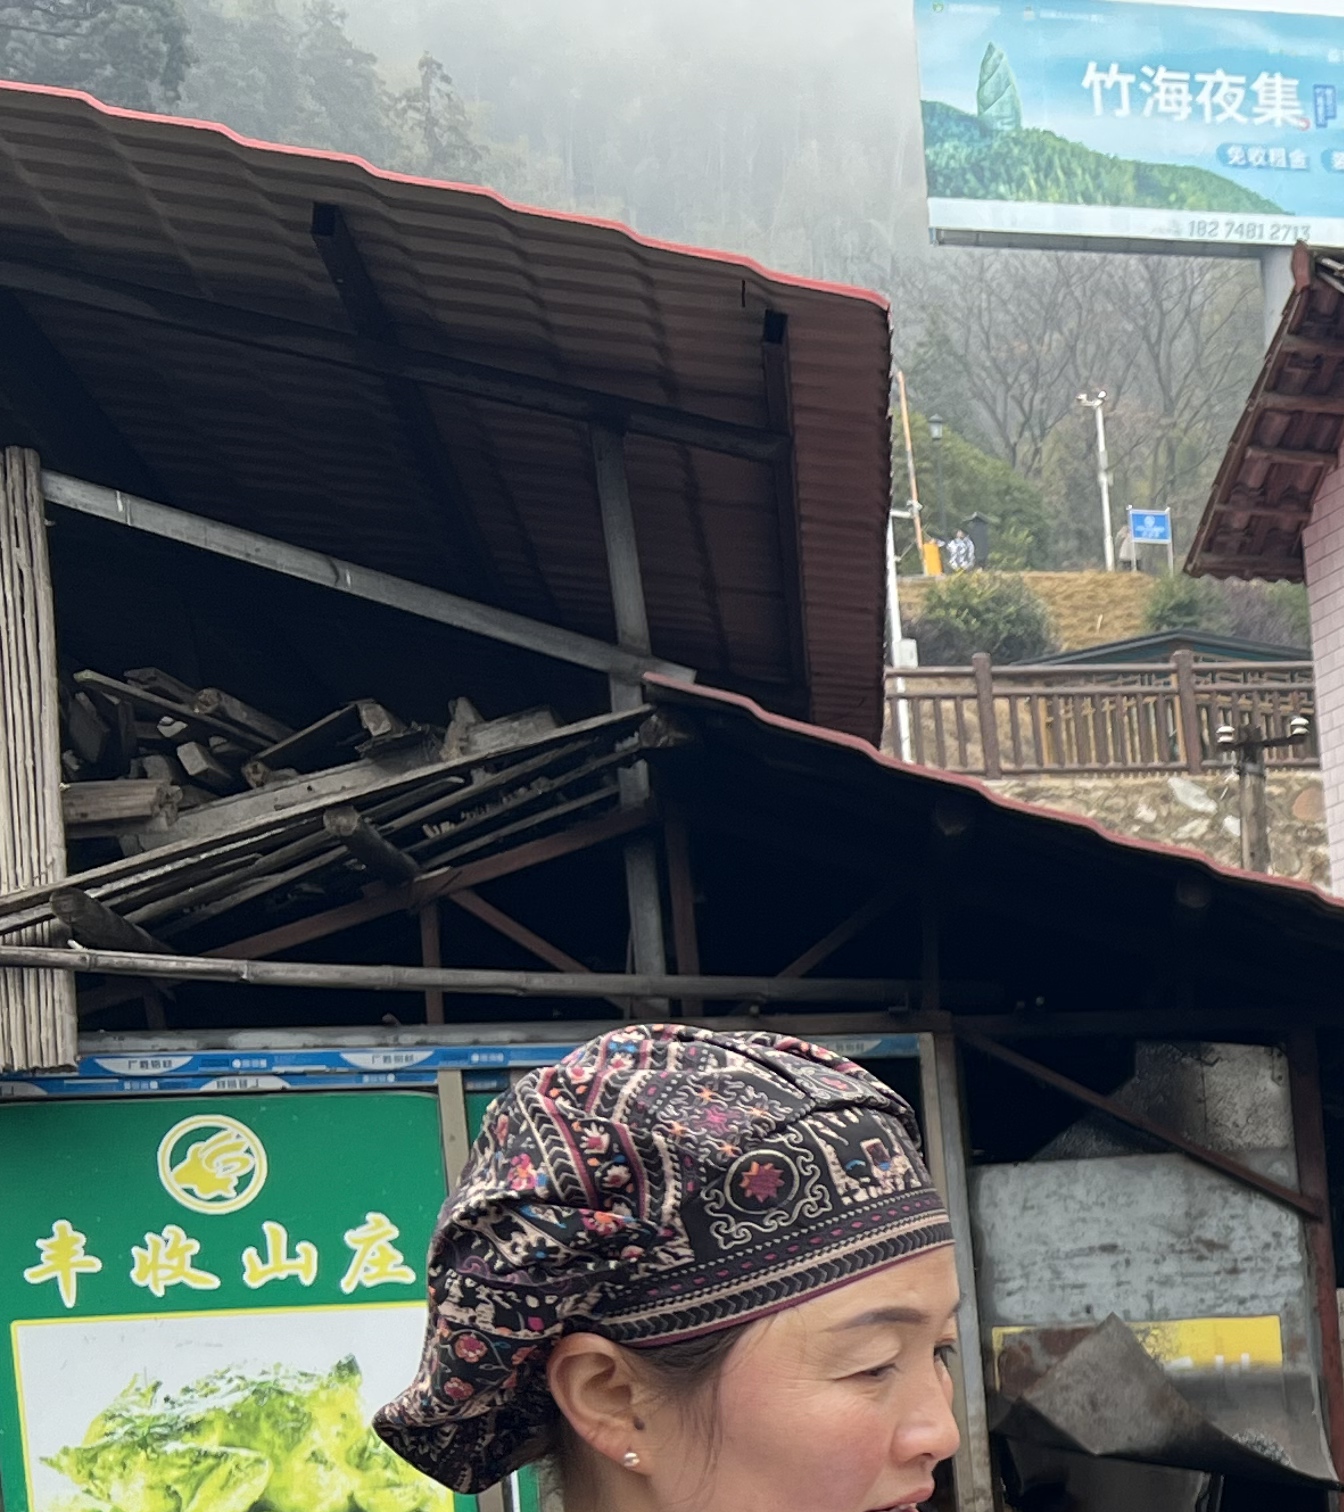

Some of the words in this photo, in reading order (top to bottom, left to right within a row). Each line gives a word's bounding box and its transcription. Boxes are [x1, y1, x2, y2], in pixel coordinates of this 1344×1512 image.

[1081, 61, 1306, 129] 竹海夜集
[23, 1212, 416, 1307] 丰收山庄
